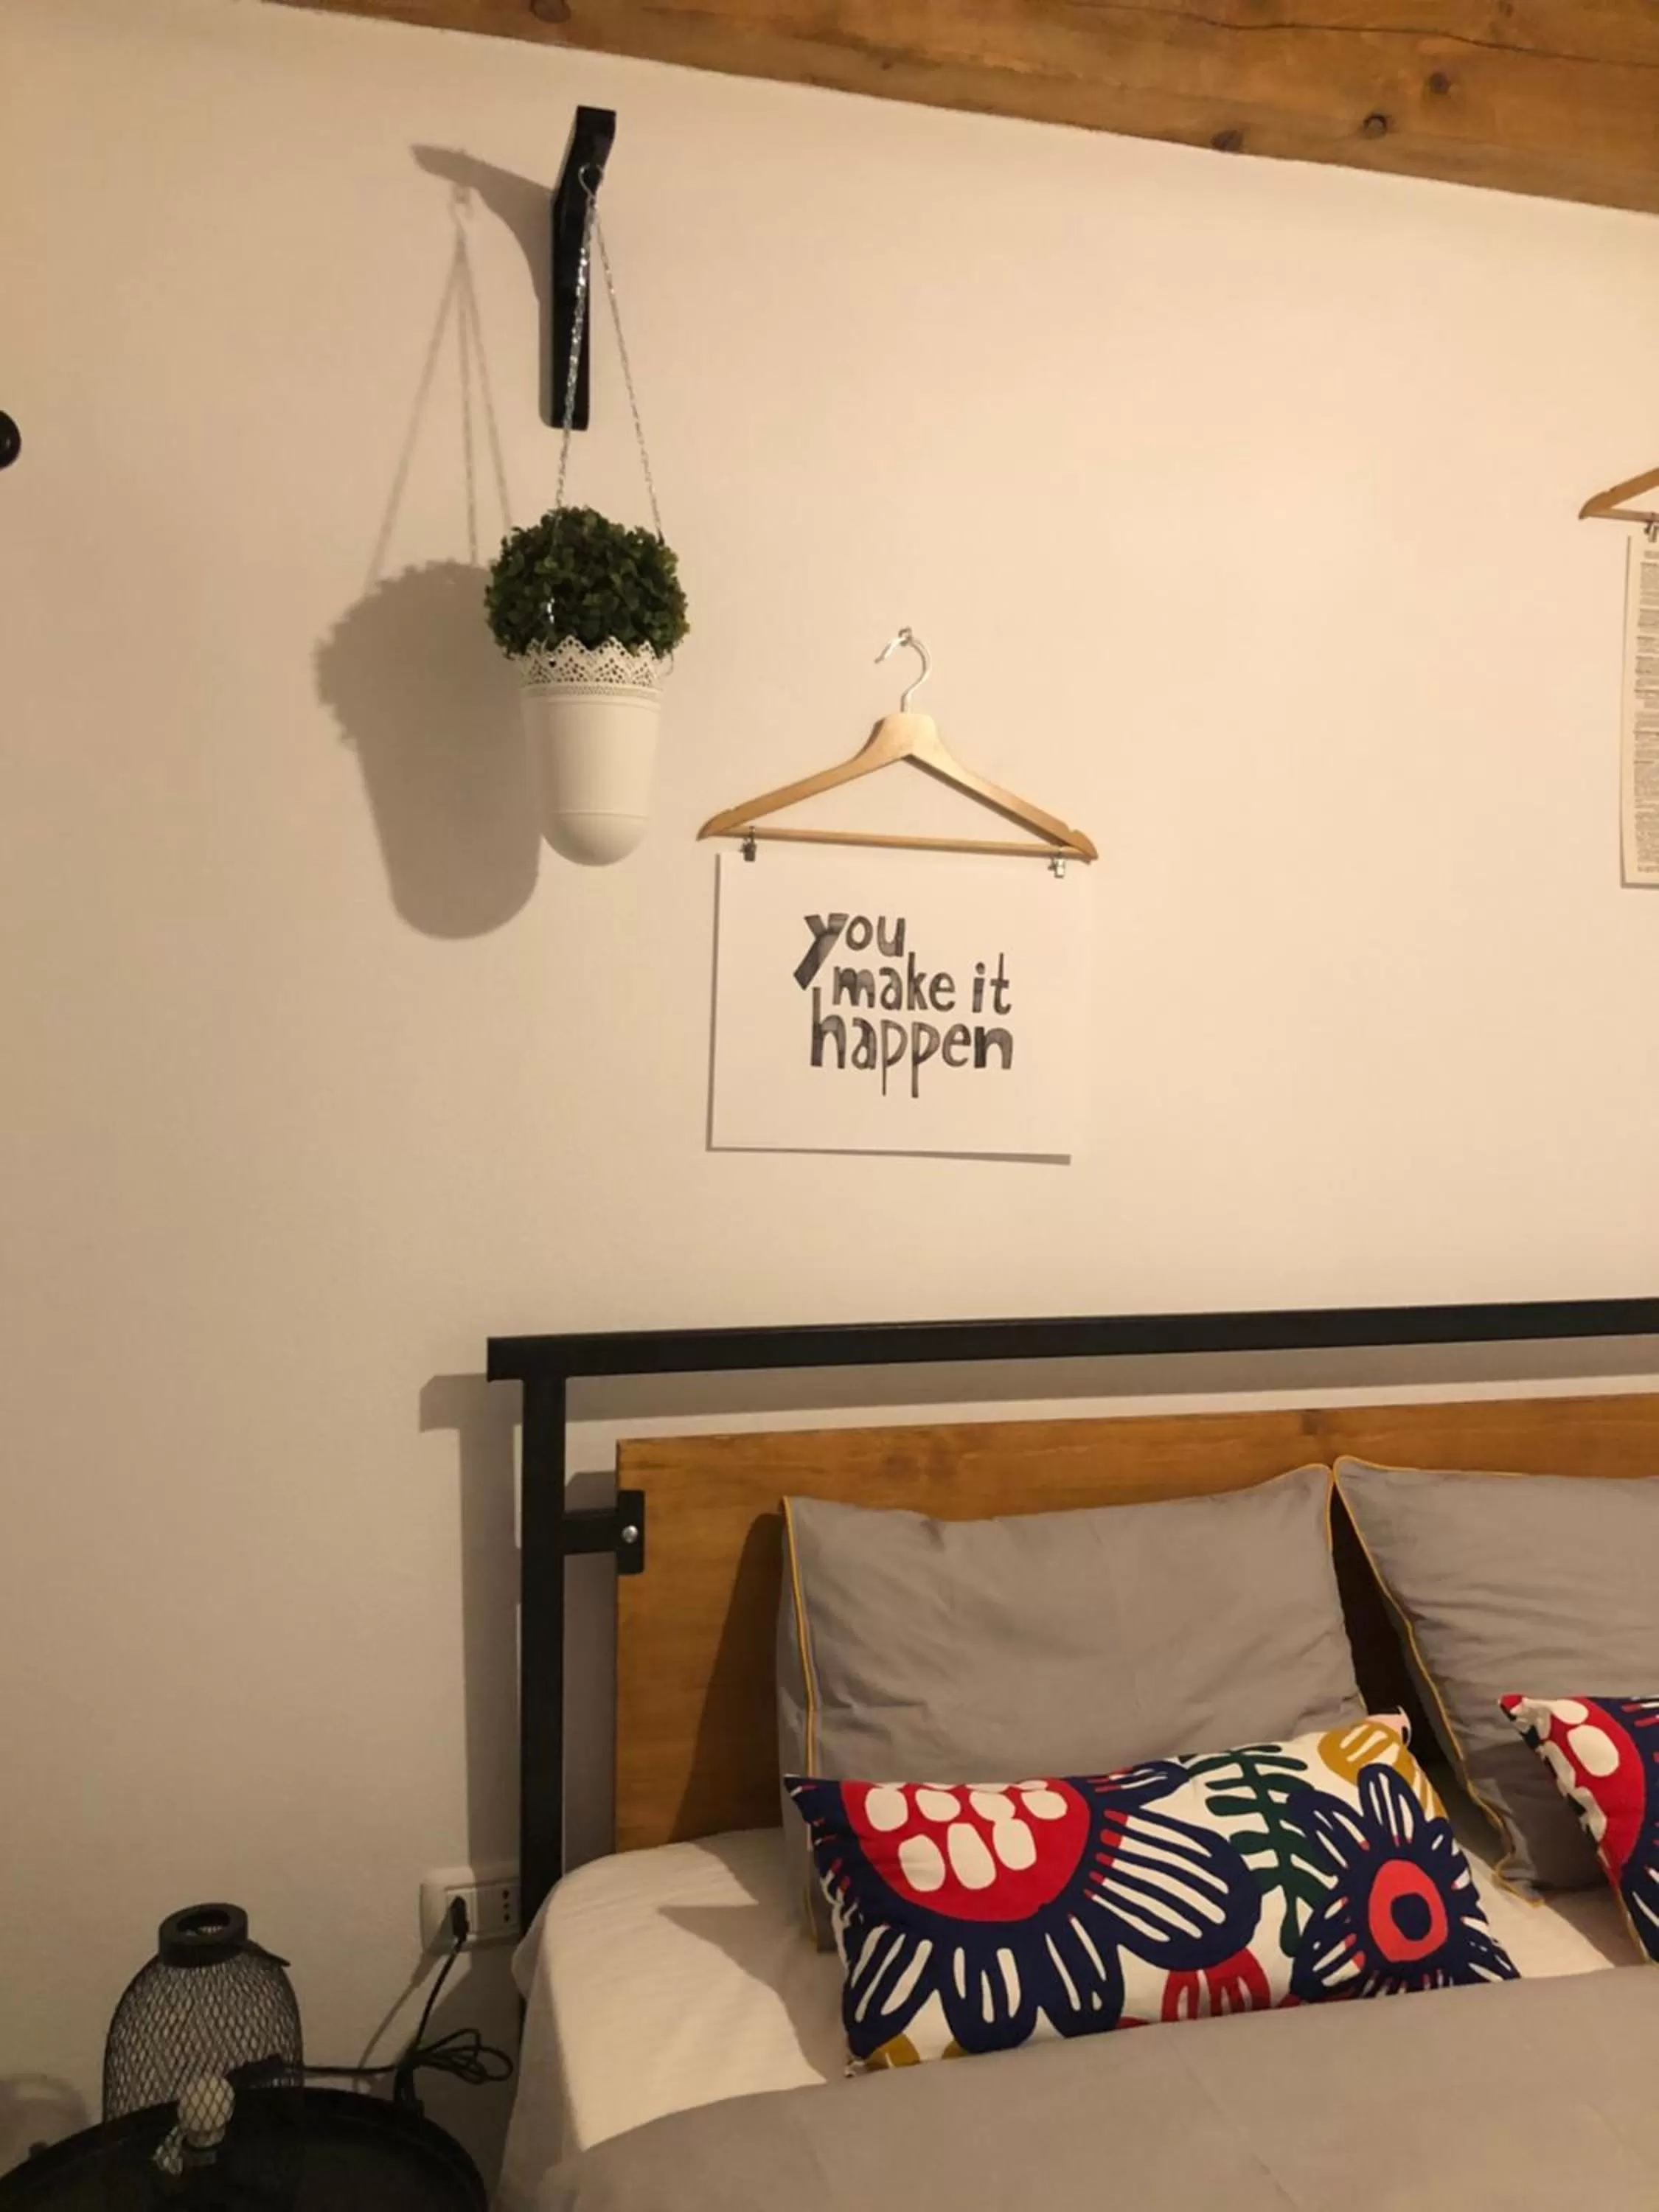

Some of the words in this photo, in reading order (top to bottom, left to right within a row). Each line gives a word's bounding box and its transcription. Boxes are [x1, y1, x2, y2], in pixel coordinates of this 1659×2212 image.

[793, 913, 905, 990] you
[832, 951, 956, 1012] make
[972, 953, 1012, 1015] it
[810, 987, 1013, 1098] happen
